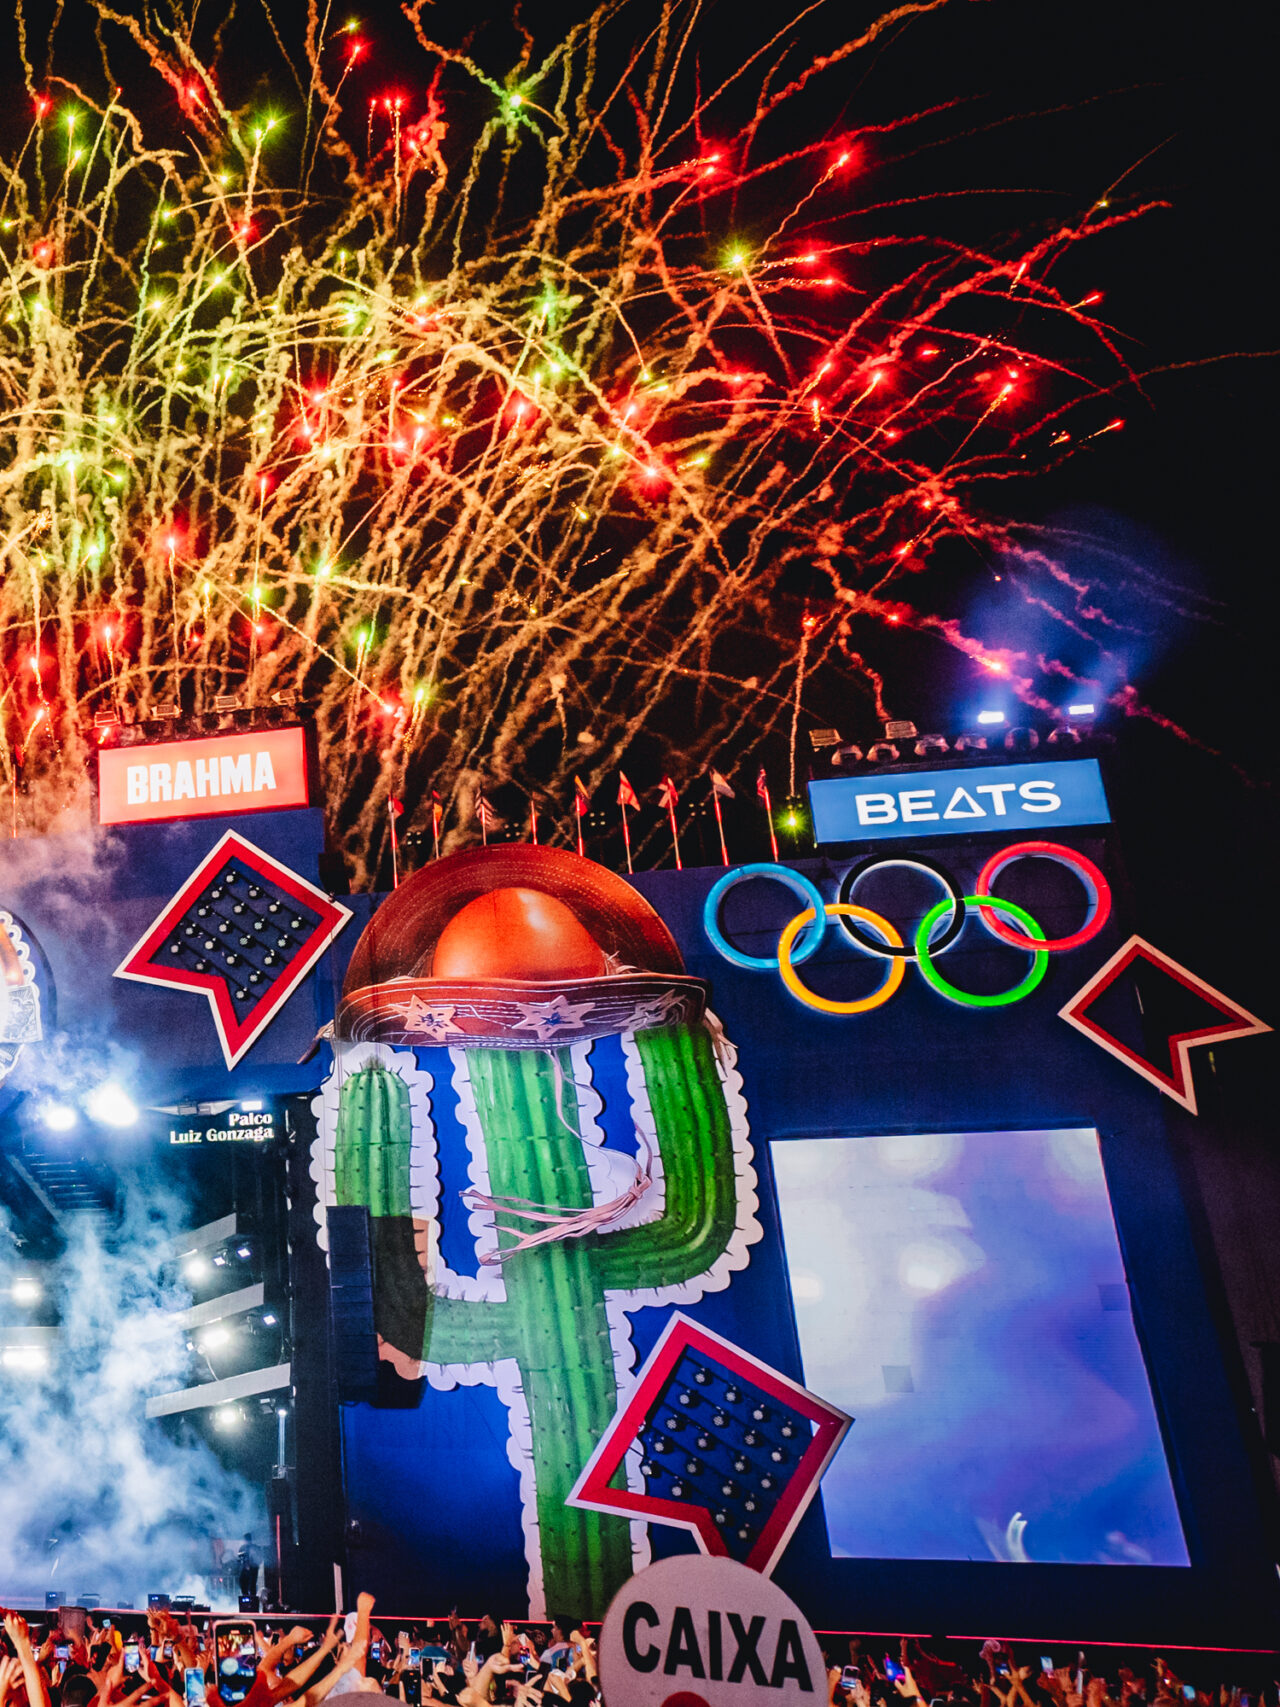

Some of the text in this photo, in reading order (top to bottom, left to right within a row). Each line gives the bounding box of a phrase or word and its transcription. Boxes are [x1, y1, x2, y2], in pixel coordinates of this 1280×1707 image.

[127, 751, 276, 804] BRAHMA
[855, 780, 1061, 825] BEATS
[170, 1126, 274, 1144] Luiz Gonzaga
[229, 1113, 272, 1127] Palco
[623, 1601, 814, 1692] CAIXA
